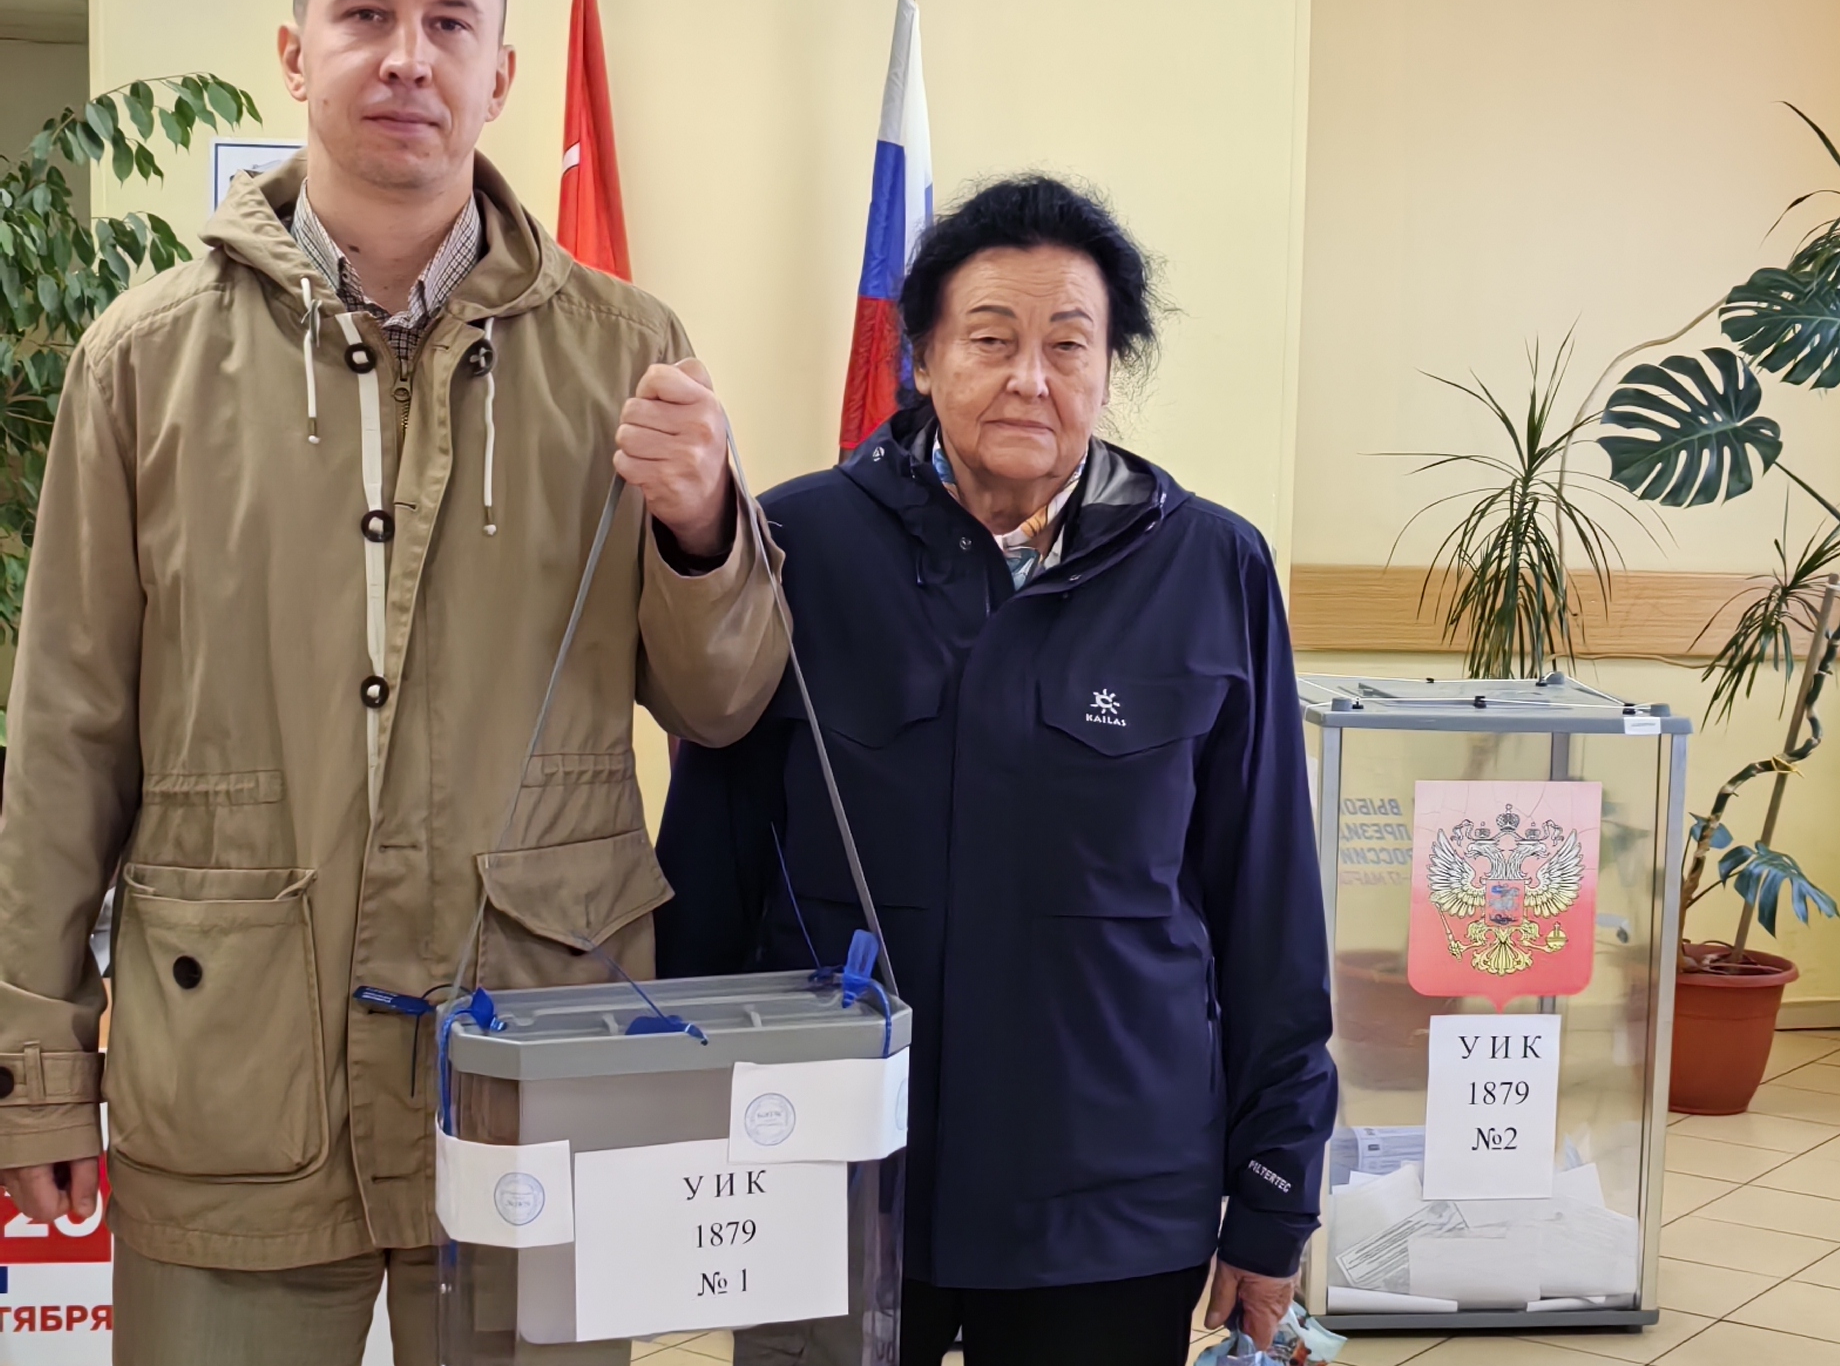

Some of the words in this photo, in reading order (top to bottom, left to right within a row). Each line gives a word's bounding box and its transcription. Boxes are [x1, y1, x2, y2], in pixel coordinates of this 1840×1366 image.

[1085, 713, 1127, 727] KAILAS
[1467, 1081, 1530, 1106] 1879
[696, 1218, 757, 1249] 1879
[697, 1270, 728, 1297] №
[740, 1267, 748, 1293] 1
